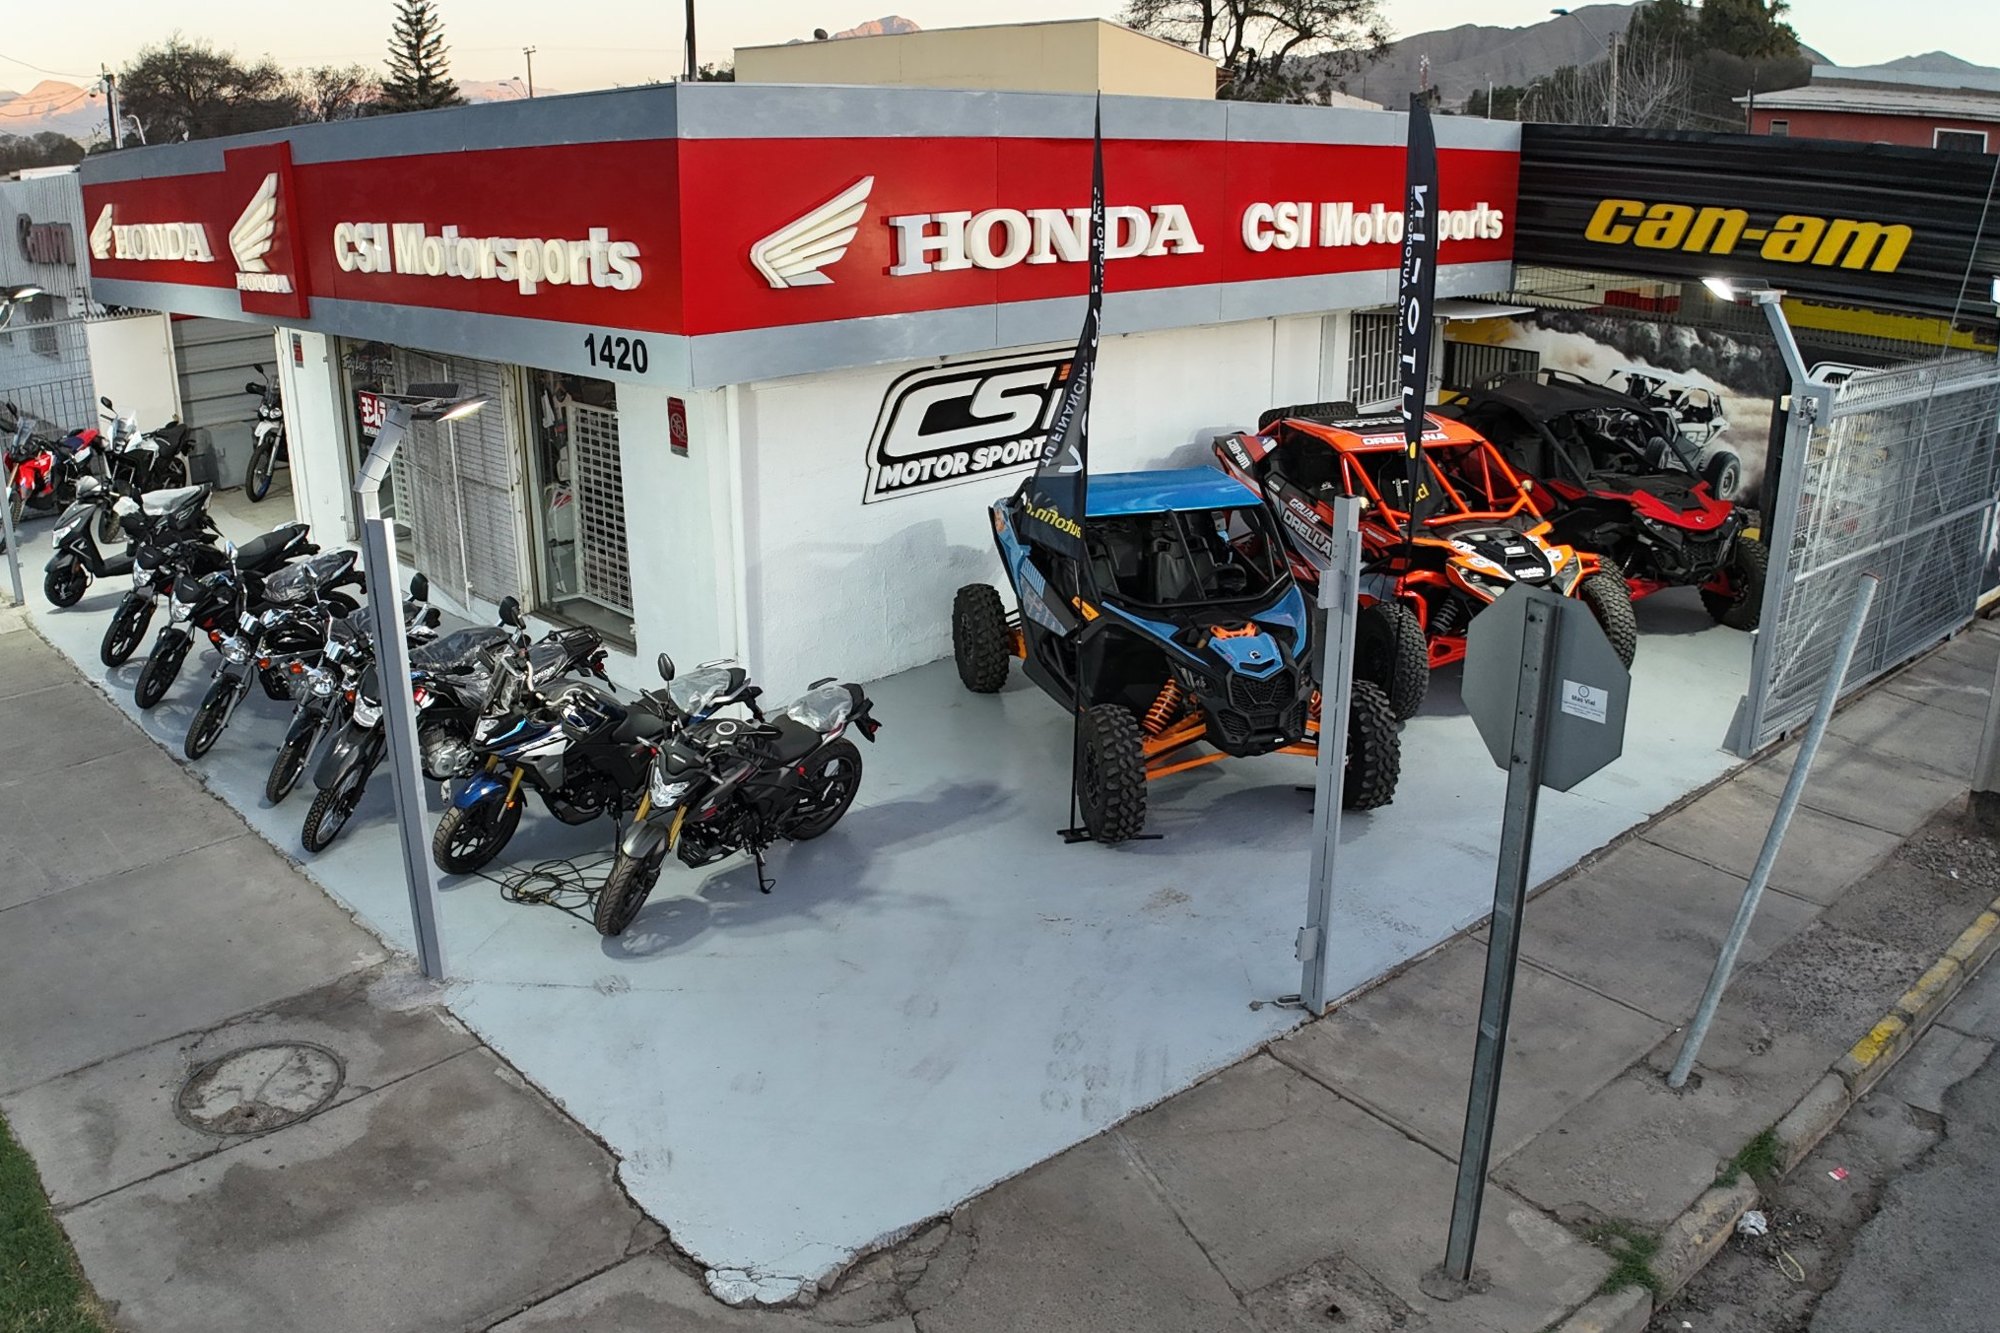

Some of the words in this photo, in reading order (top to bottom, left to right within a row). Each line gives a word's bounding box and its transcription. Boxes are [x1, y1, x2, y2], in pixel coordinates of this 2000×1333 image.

[112, 222, 215, 262] HONDA
[889, 204, 1204, 277] HONDA
[1242, 202, 1312, 252] CSI
[1319, 202, 1503, 250] Motoports
[235, 272, 293, 293] HONDA
[334, 222, 391, 273] CSI
[392, 223, 642, 295] Motorsports
[584, 333, 648, 374] 1420
[877, 451, 968, 490] MOTOR
[970, 436, 1048, 472] SPORT
[1283, 508, 1332, 559] ORELLA
